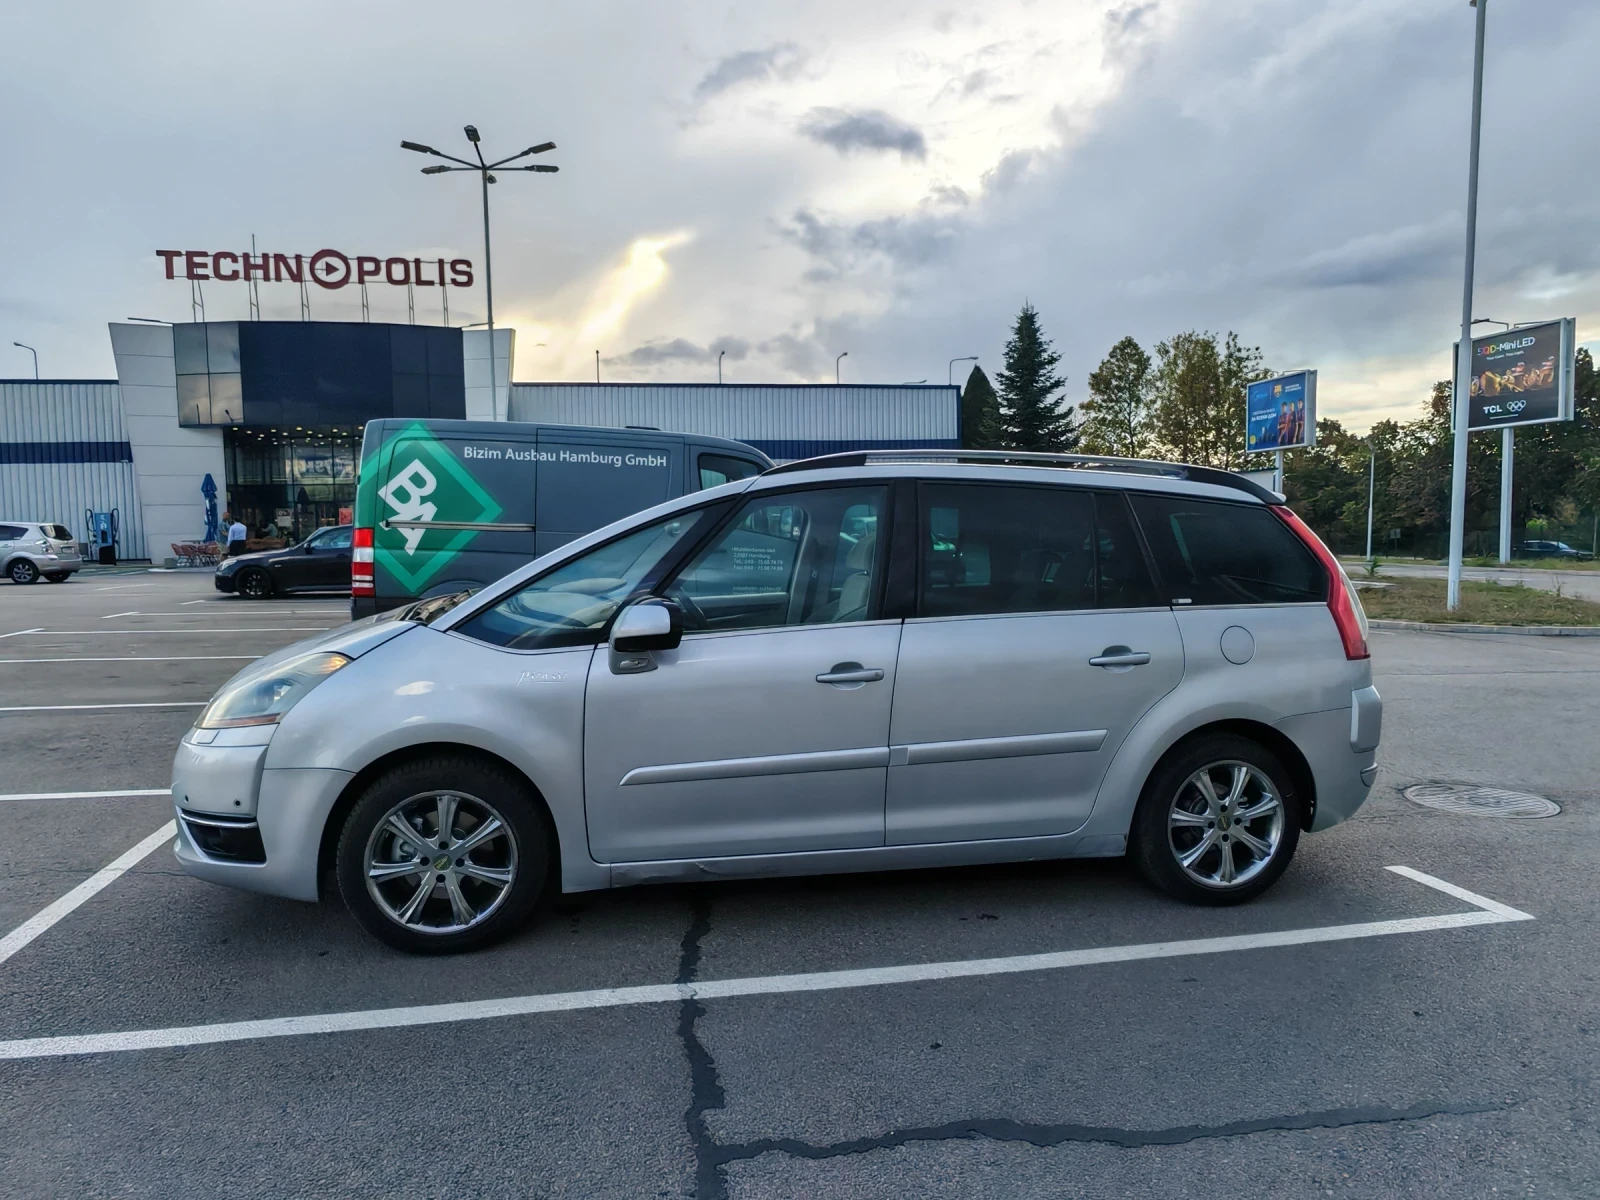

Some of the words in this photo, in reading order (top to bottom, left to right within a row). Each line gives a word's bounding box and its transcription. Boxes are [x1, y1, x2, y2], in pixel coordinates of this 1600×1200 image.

[156, 248, 474, 289] TECHNOPOLIS
[1483, 404, 1502, 414] TCL
[463, 446, 502, 460] Bizim
[505, 448, 556, 462] Ausbau
[559, 450, 622, 467] Hamburg
[625, 453, 667, 467] GmbH
